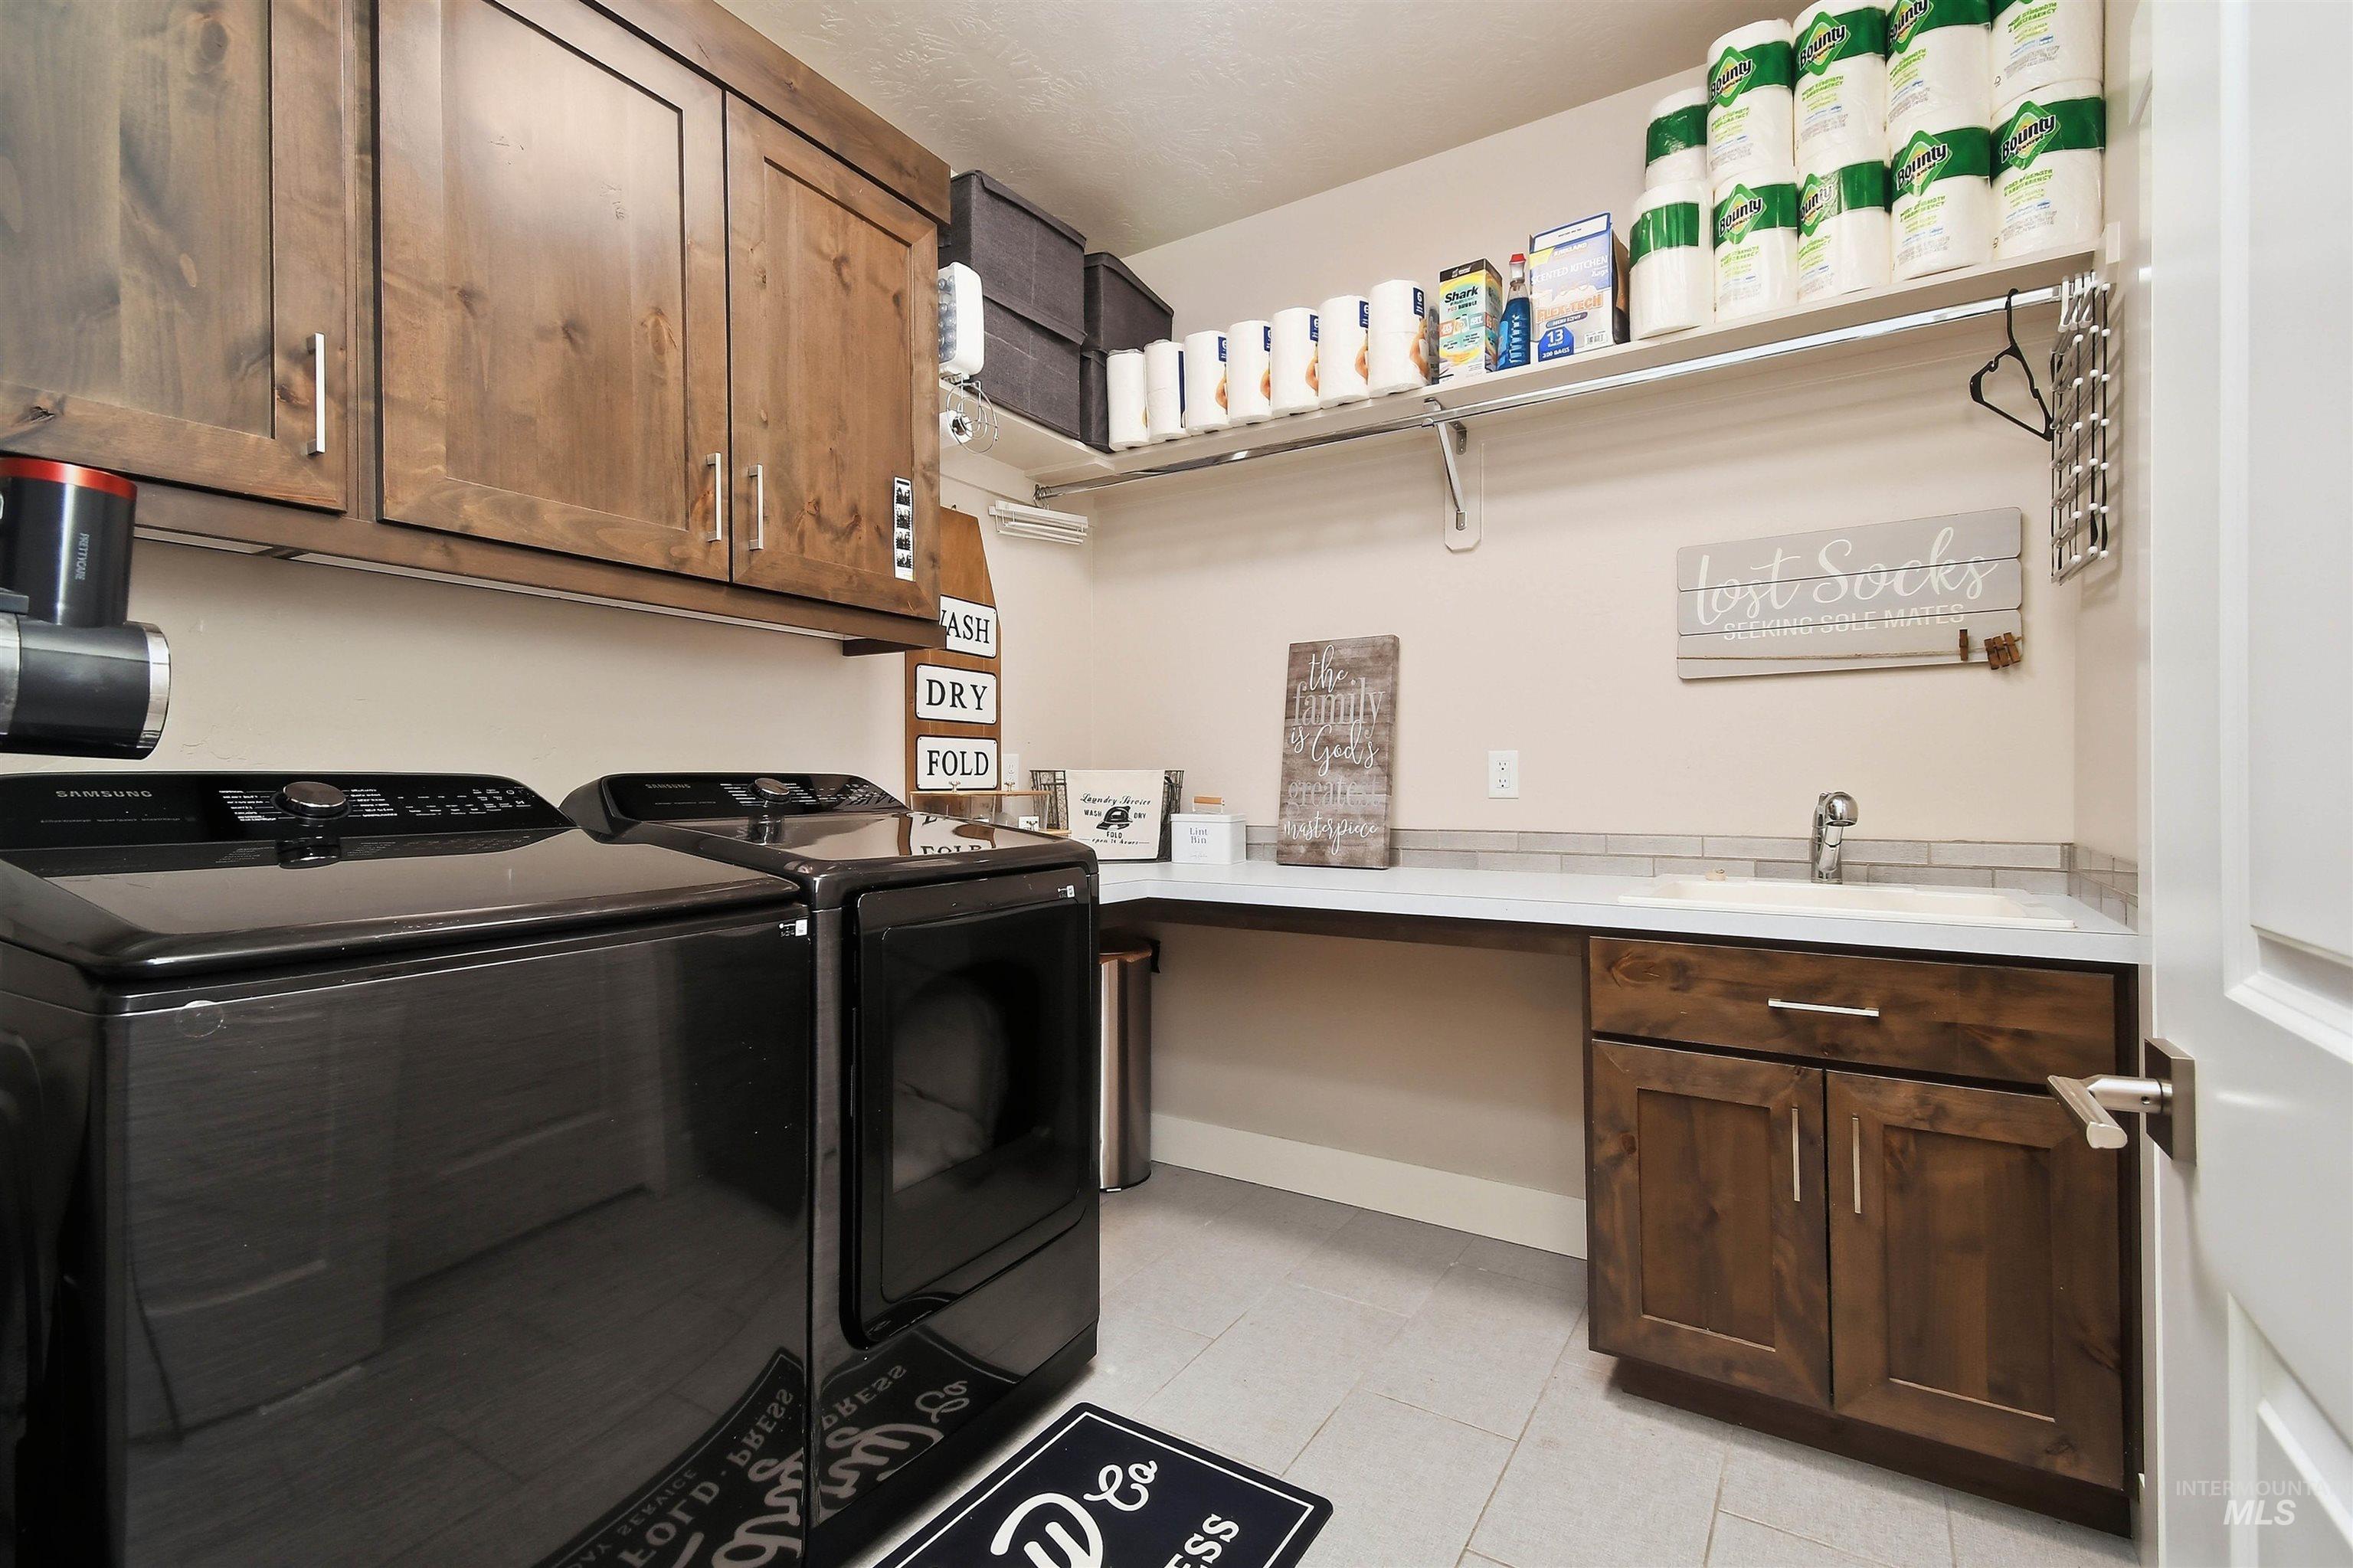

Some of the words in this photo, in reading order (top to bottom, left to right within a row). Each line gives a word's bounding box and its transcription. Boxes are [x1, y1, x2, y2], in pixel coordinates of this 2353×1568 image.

[1800, 25, 1846, 70] Bounty
[1710, 59, 1752, 102] Bounty
[2001, 115, 2057, 163] Bounty
[1896, 143, 1948, 191] Bounty
[1719, 197, 1763, 237] Bounty
[1800, 185, 1832, 221] ounty
[1570, 255, 1608, 273] KITCHEN
[1445, 286, 1478, 303] Shark
[1547, 329, 1563, 343] 13
[1812, 526, 2000, 604] Socks
[1723, 616, 1815, 641] SEEKING
[1820, 611, 1879, 634] SOLE
[1883, 603, 1965, 628] MATES
[1308, 644, 1348, 692] the
[926, 679, 987, 711] DRY
[1293, 676, 1385, 738] family
[1291, 726, 1310, 754] is
[927, 750, 989, 777] FOLD
[1080, 794, 1118, 805] Laundry
[1119, 794, 1151, 805] Service
[1084, 809, 1101, 817] WASH
[1288, 776, 1382, 819] greatest
[1190, 827, 1208, 836] Lint
[1191, 835, 1207, 844] Bin
[1284, 810, 1378, 856] masterpiece
